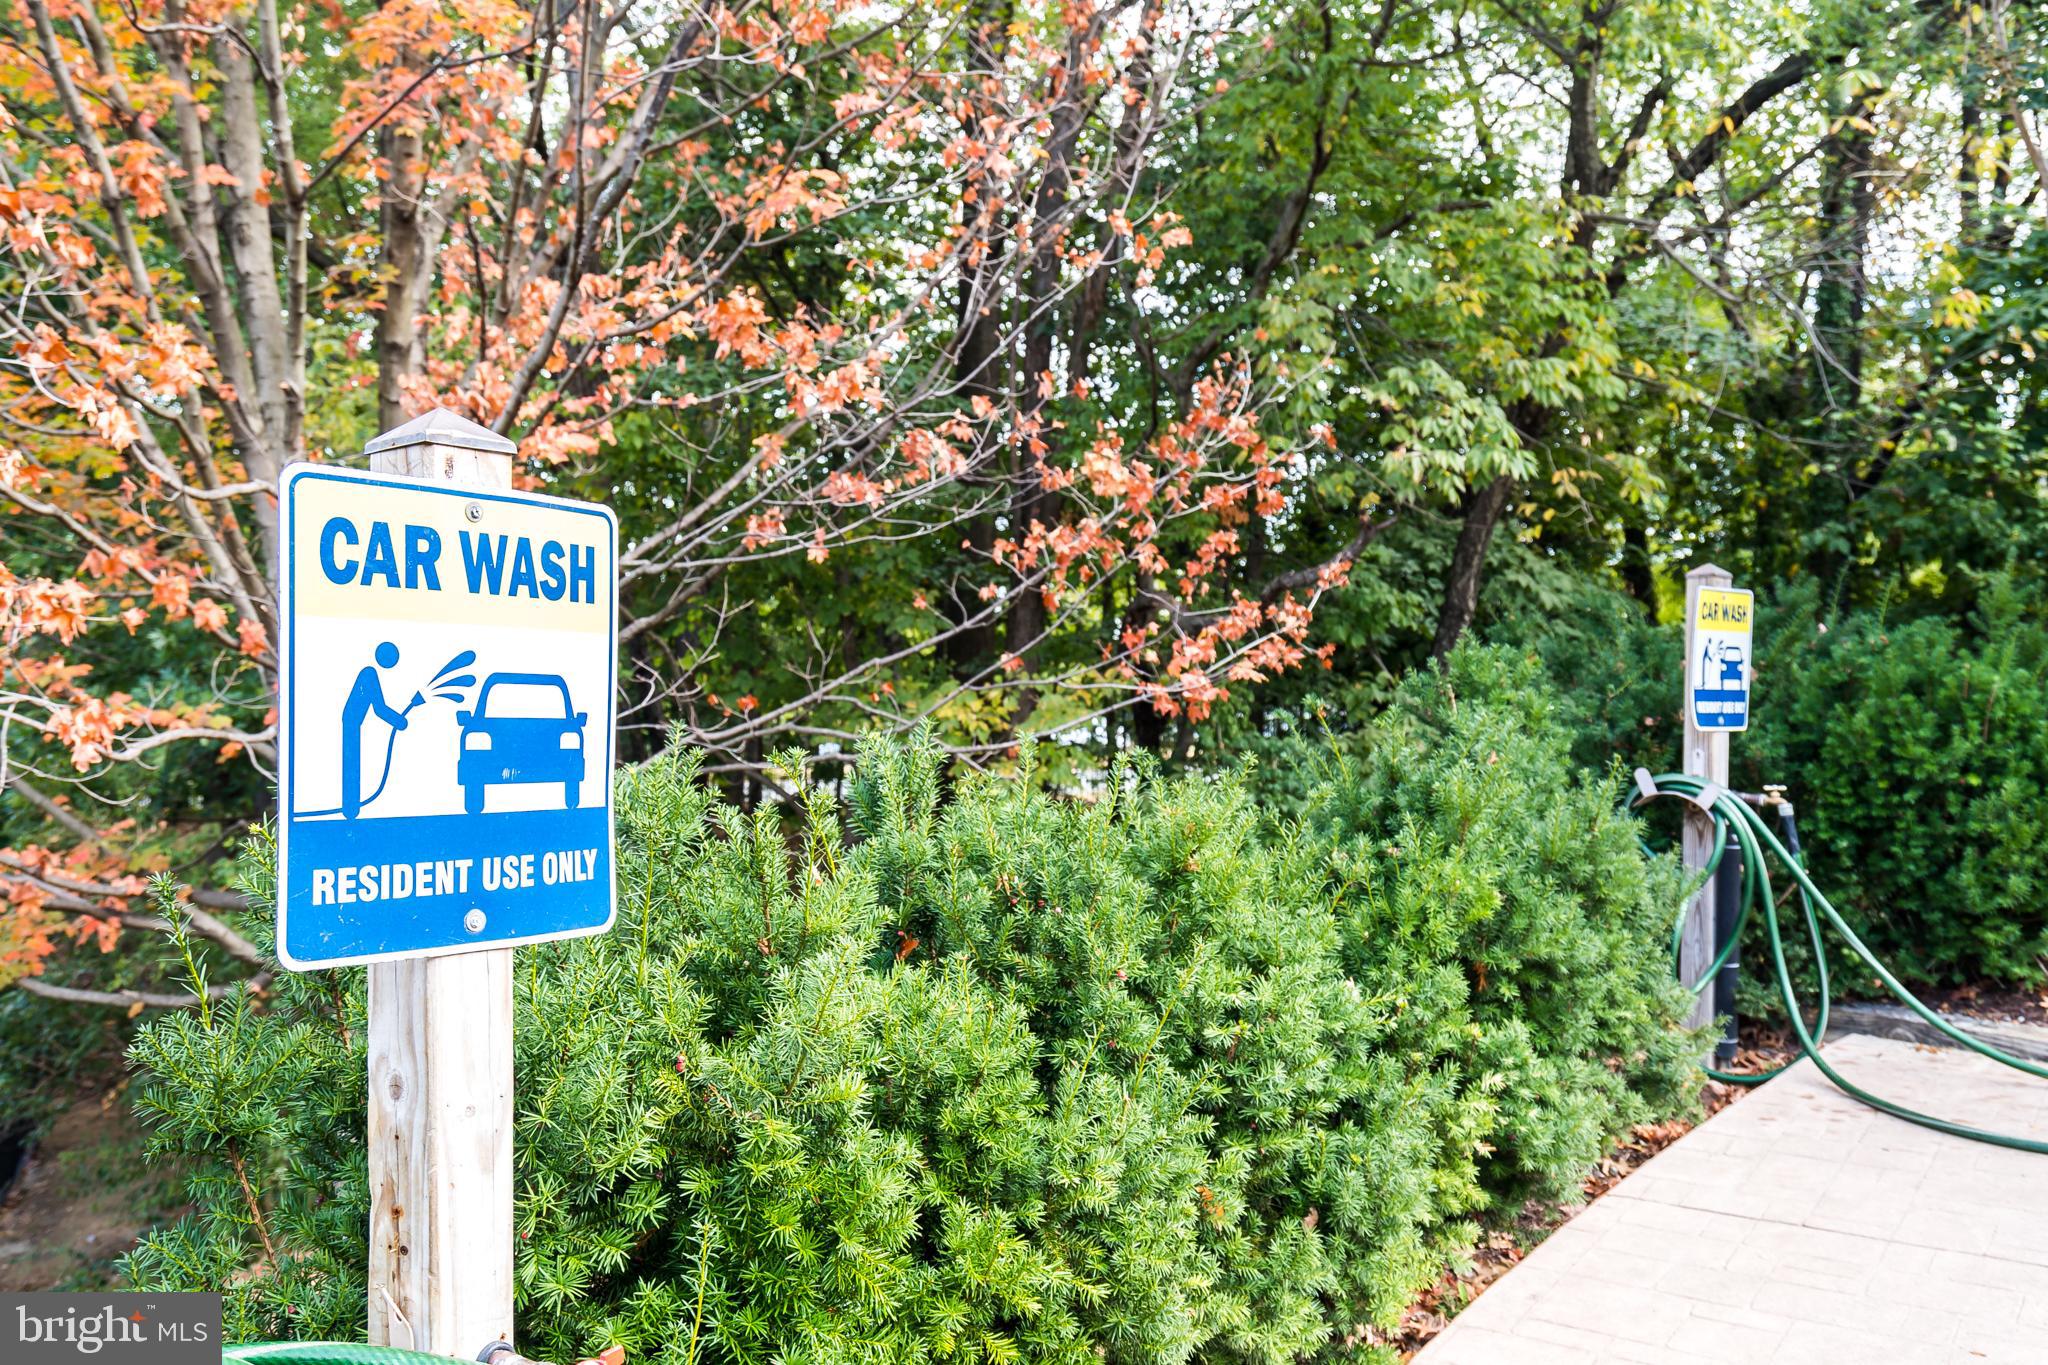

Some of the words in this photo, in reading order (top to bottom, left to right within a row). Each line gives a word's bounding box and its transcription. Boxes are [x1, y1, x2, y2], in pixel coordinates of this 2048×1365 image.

[319, 517, 441, 591] CAR
[459, 530, 595, 604] WASH
[1722, 605, 1748, 623] WASH
[313, 859, 473, 906] RESIDENT
[483, 854, 534, 891] USE
[542, 849, 598, 885] ONLY
